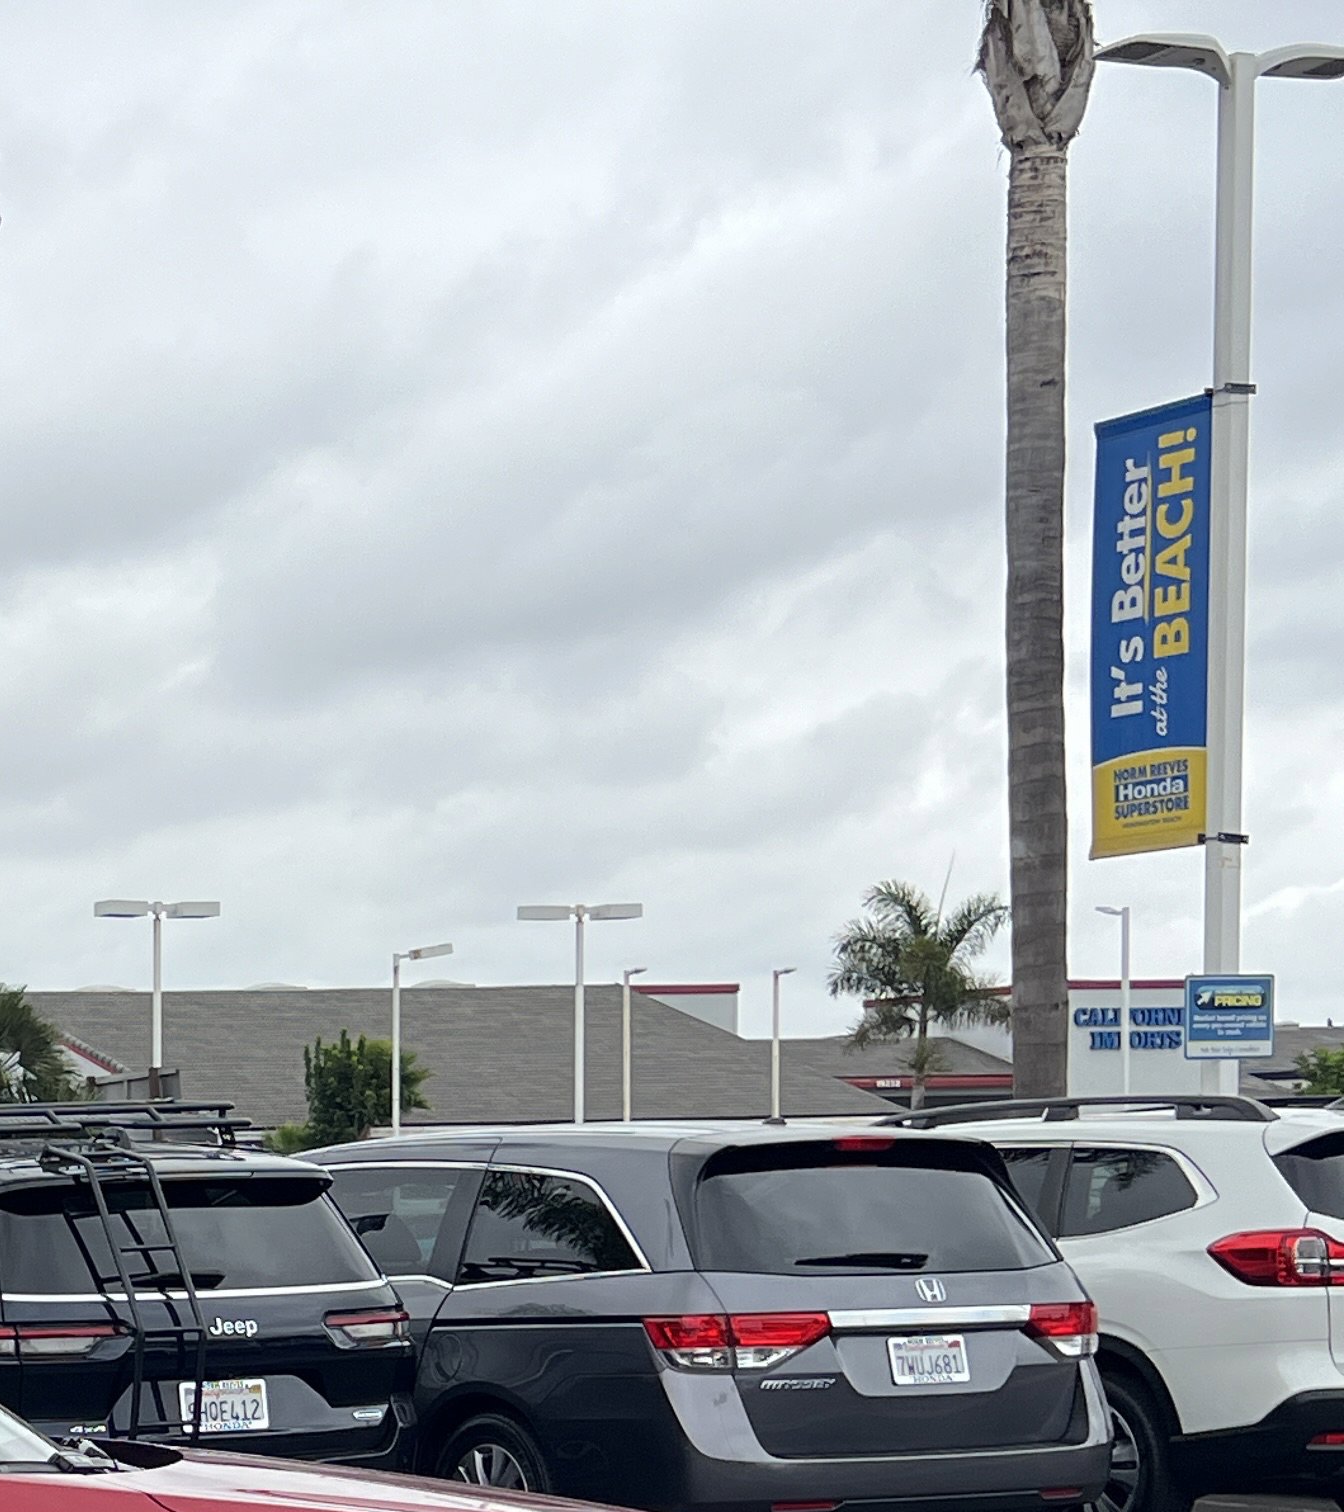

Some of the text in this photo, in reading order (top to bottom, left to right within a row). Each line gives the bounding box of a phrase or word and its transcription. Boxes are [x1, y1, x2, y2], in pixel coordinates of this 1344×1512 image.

[1110, 457, 1150, 719] It's Better
[1153, 426, 1198, 737] at the BEACH!
[1114, 759, 1188, 783] NORM REEVES
[1118, 778, 1184, 801] Honda
[1114, 795, 1189, 820] SUPERSTORE
[1214, 994, 1262, 1007] PRICING
[1074, 1007, 1185, 1027] CALIORNI
[209, 1317, 259, 1338] Jeep
[896, 1353, 965, 1376] 7WUJ681
